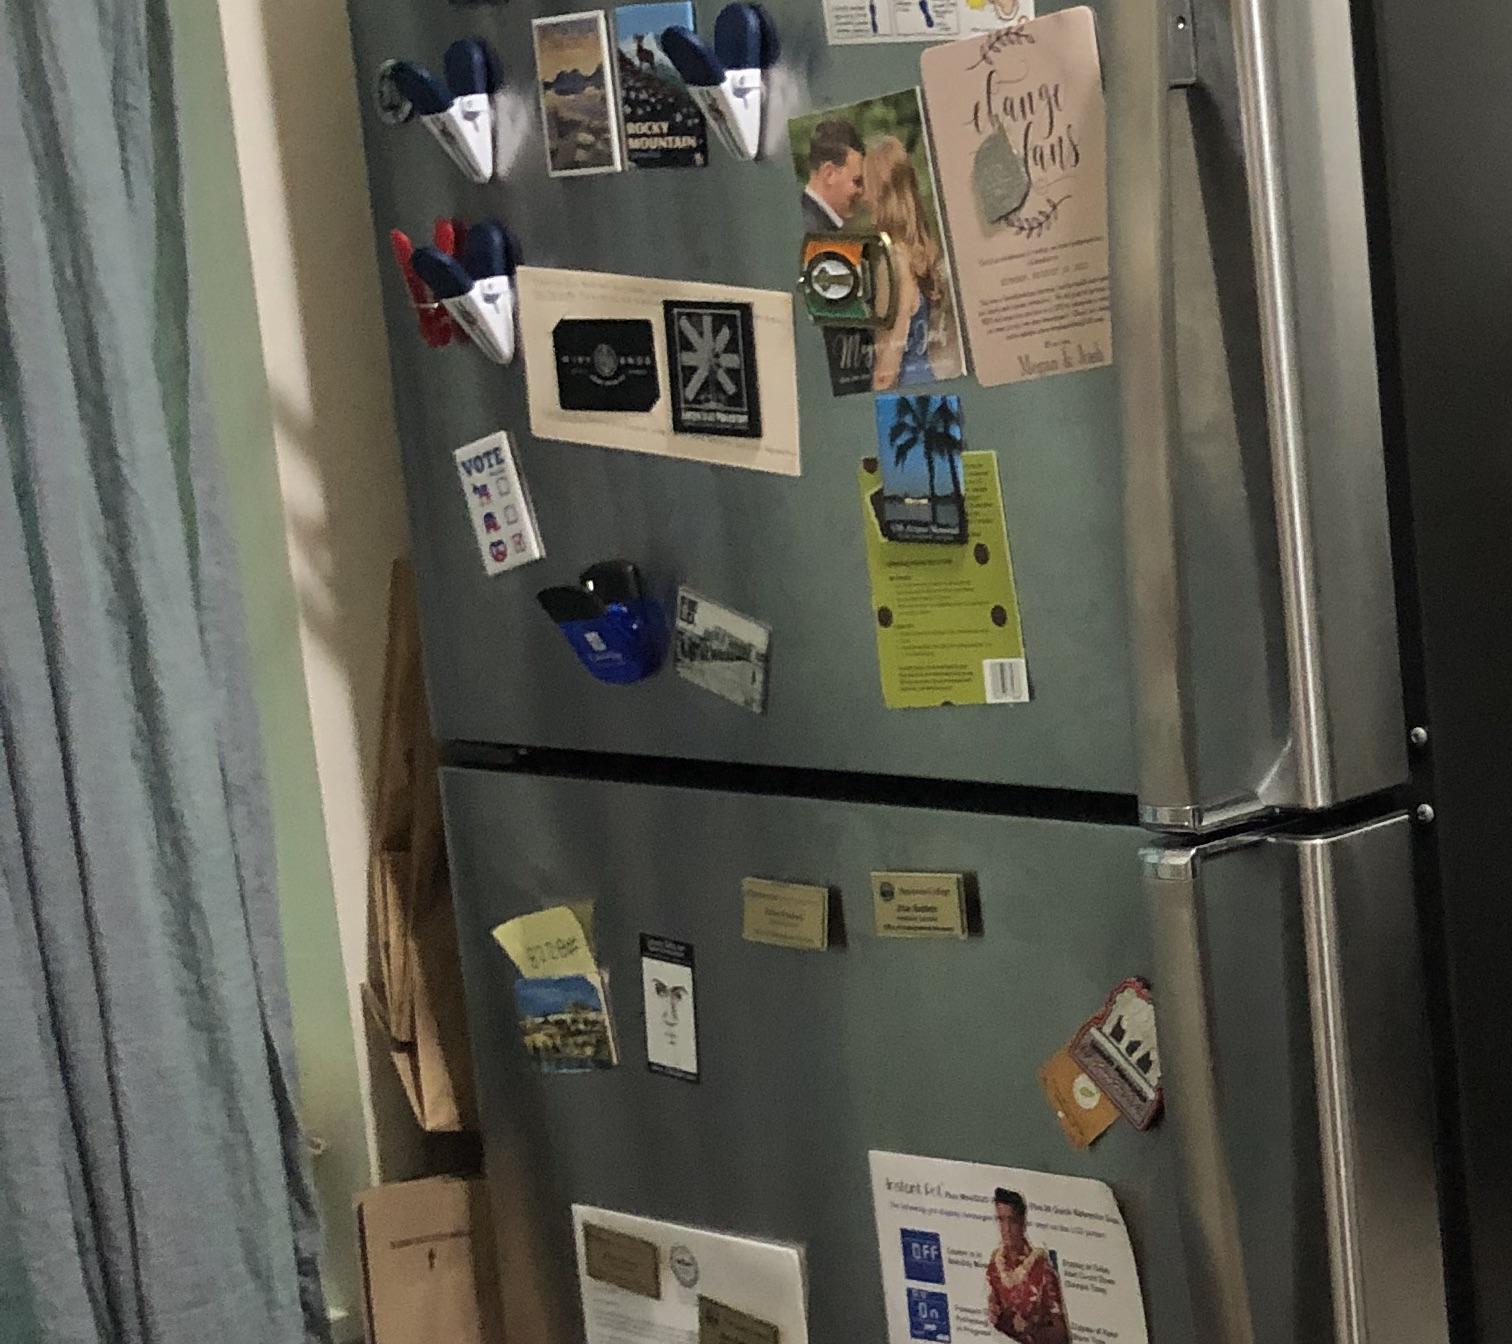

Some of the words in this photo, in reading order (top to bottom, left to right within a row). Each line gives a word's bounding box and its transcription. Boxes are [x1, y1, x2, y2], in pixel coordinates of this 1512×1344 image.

[626, 120, 669, 135] ROCKY
[627, 136, 697, 150] MOUNTAIN
[461, 447, 505, 476] VOTE
